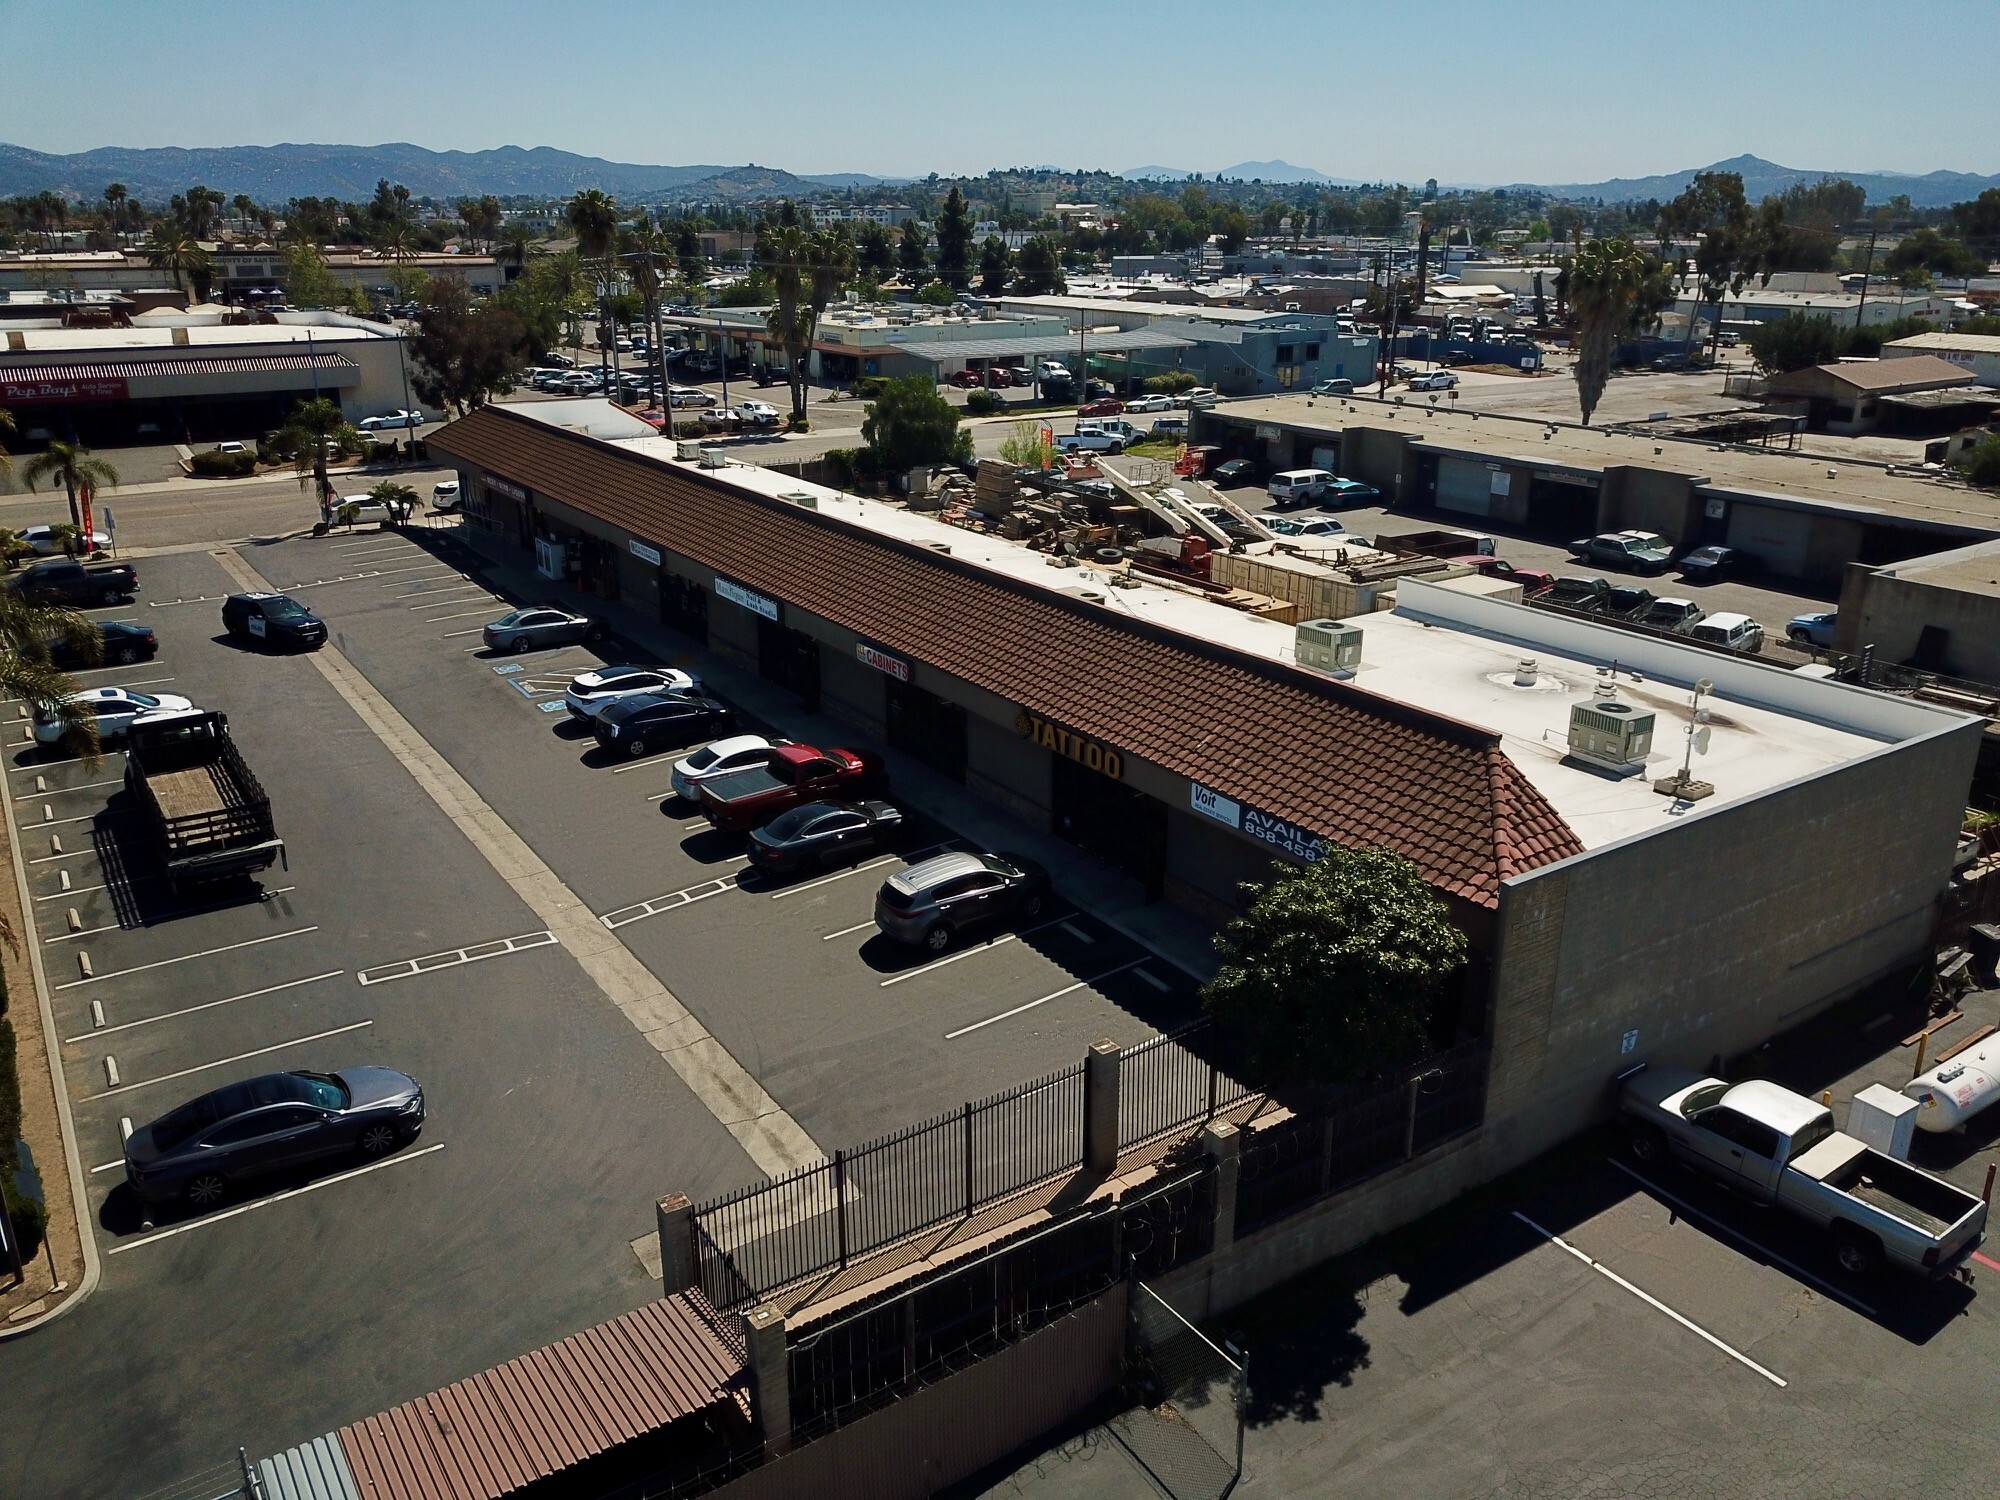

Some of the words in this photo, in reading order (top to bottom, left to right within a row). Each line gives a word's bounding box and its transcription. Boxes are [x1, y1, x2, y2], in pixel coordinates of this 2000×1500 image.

[5, 385, 37, 398] Pep
[38, 384, 79, 397] Boys
[746, 600, 759, 611] Lash
[759, 606, 776, 618] Studio
[867, 650, 908, 679] CABINETS
[1029, 716, 1121, 780] TATTOO
[1195, 785, 1217, 809] Voit
[1194, 803, 1203, 811] REAL
[1203, 806, 1216, 816] ESTATE
[1215, 812, 1232, 824] SERVICES
[1245, 810, 1329, 856] AVAILA
